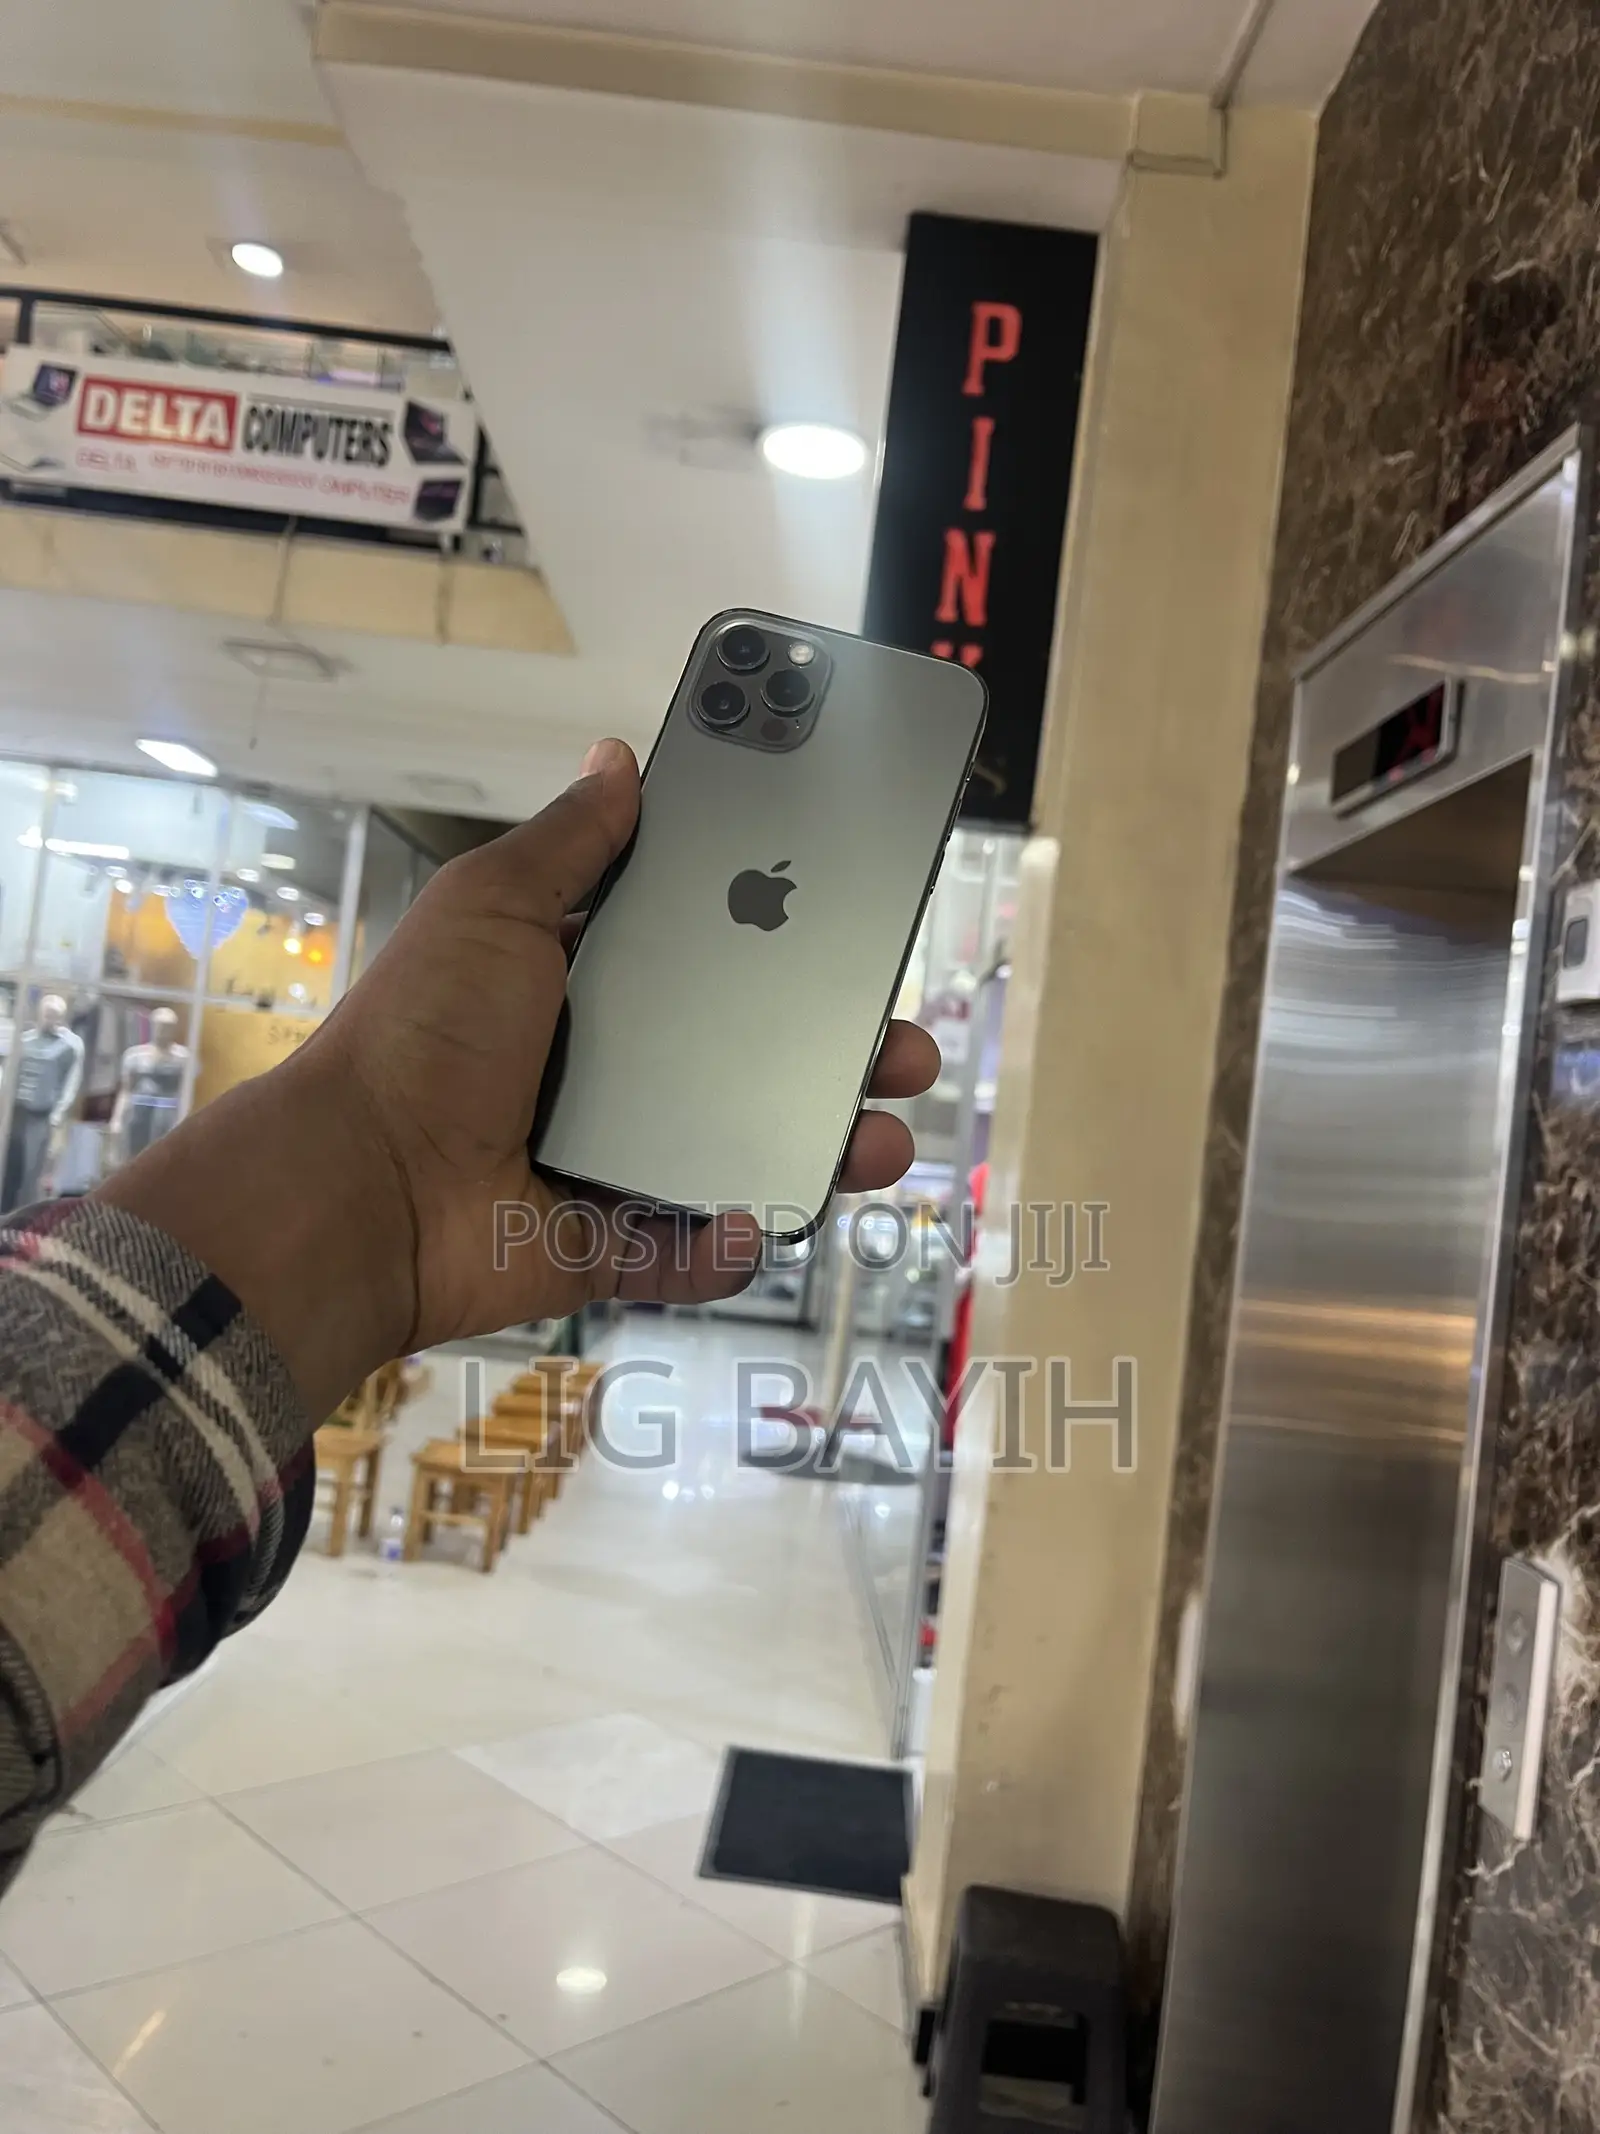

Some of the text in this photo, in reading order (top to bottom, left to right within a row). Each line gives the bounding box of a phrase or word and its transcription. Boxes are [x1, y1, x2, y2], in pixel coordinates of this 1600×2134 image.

[83, 386, 394, 468] DELTA COMPUTERS
[930, 301, 1023, 669] PIN
